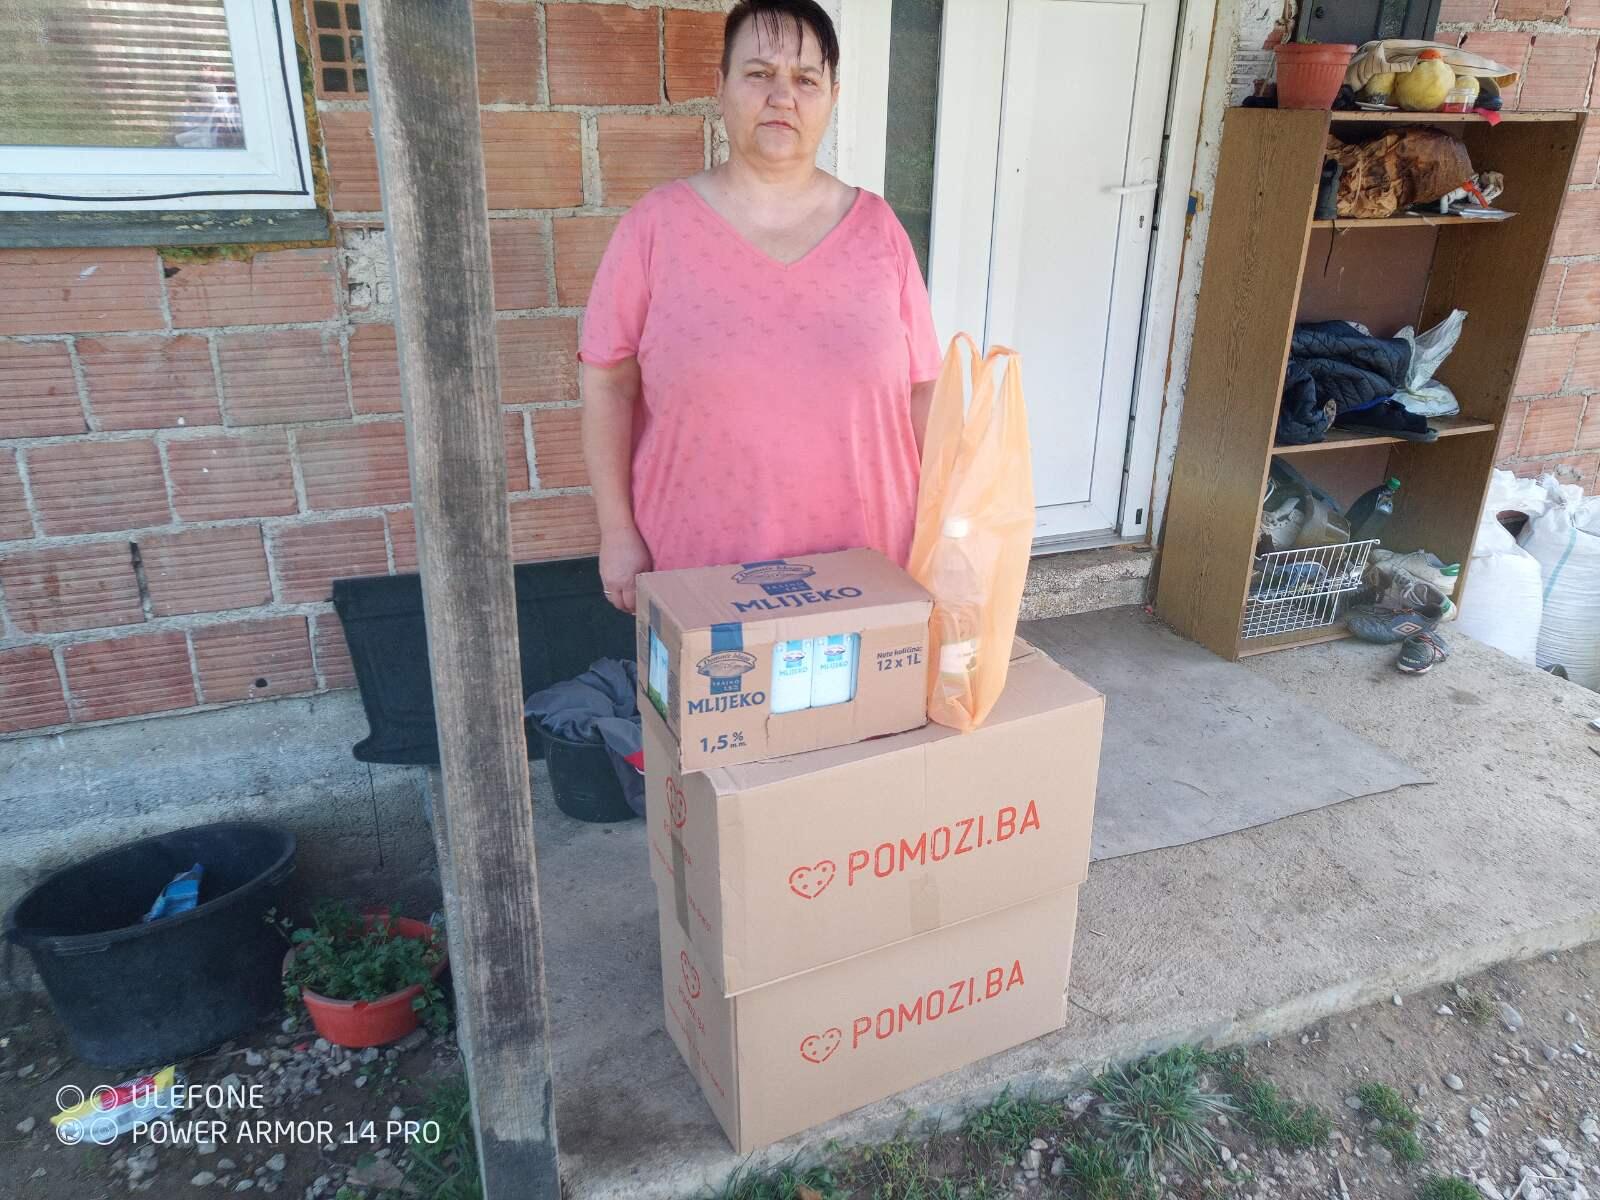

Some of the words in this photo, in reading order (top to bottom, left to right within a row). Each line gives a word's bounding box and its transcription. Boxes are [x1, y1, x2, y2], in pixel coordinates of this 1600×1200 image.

[731, 587, 863, 612] MLIJEKO
[877, 658, 892, 671] 12
[895, 658, 903, 668] x
[907, 652, 921, 665] 1L
[687, 691, 766, 715] MLIJEKO
[700, 734, 728, 753] 1,5
[732, 731, 744, 742] %
[848, 800, 1040, 887] POMOZI.BA
[852, 960, 1025, 1049] POMOZI.BA
